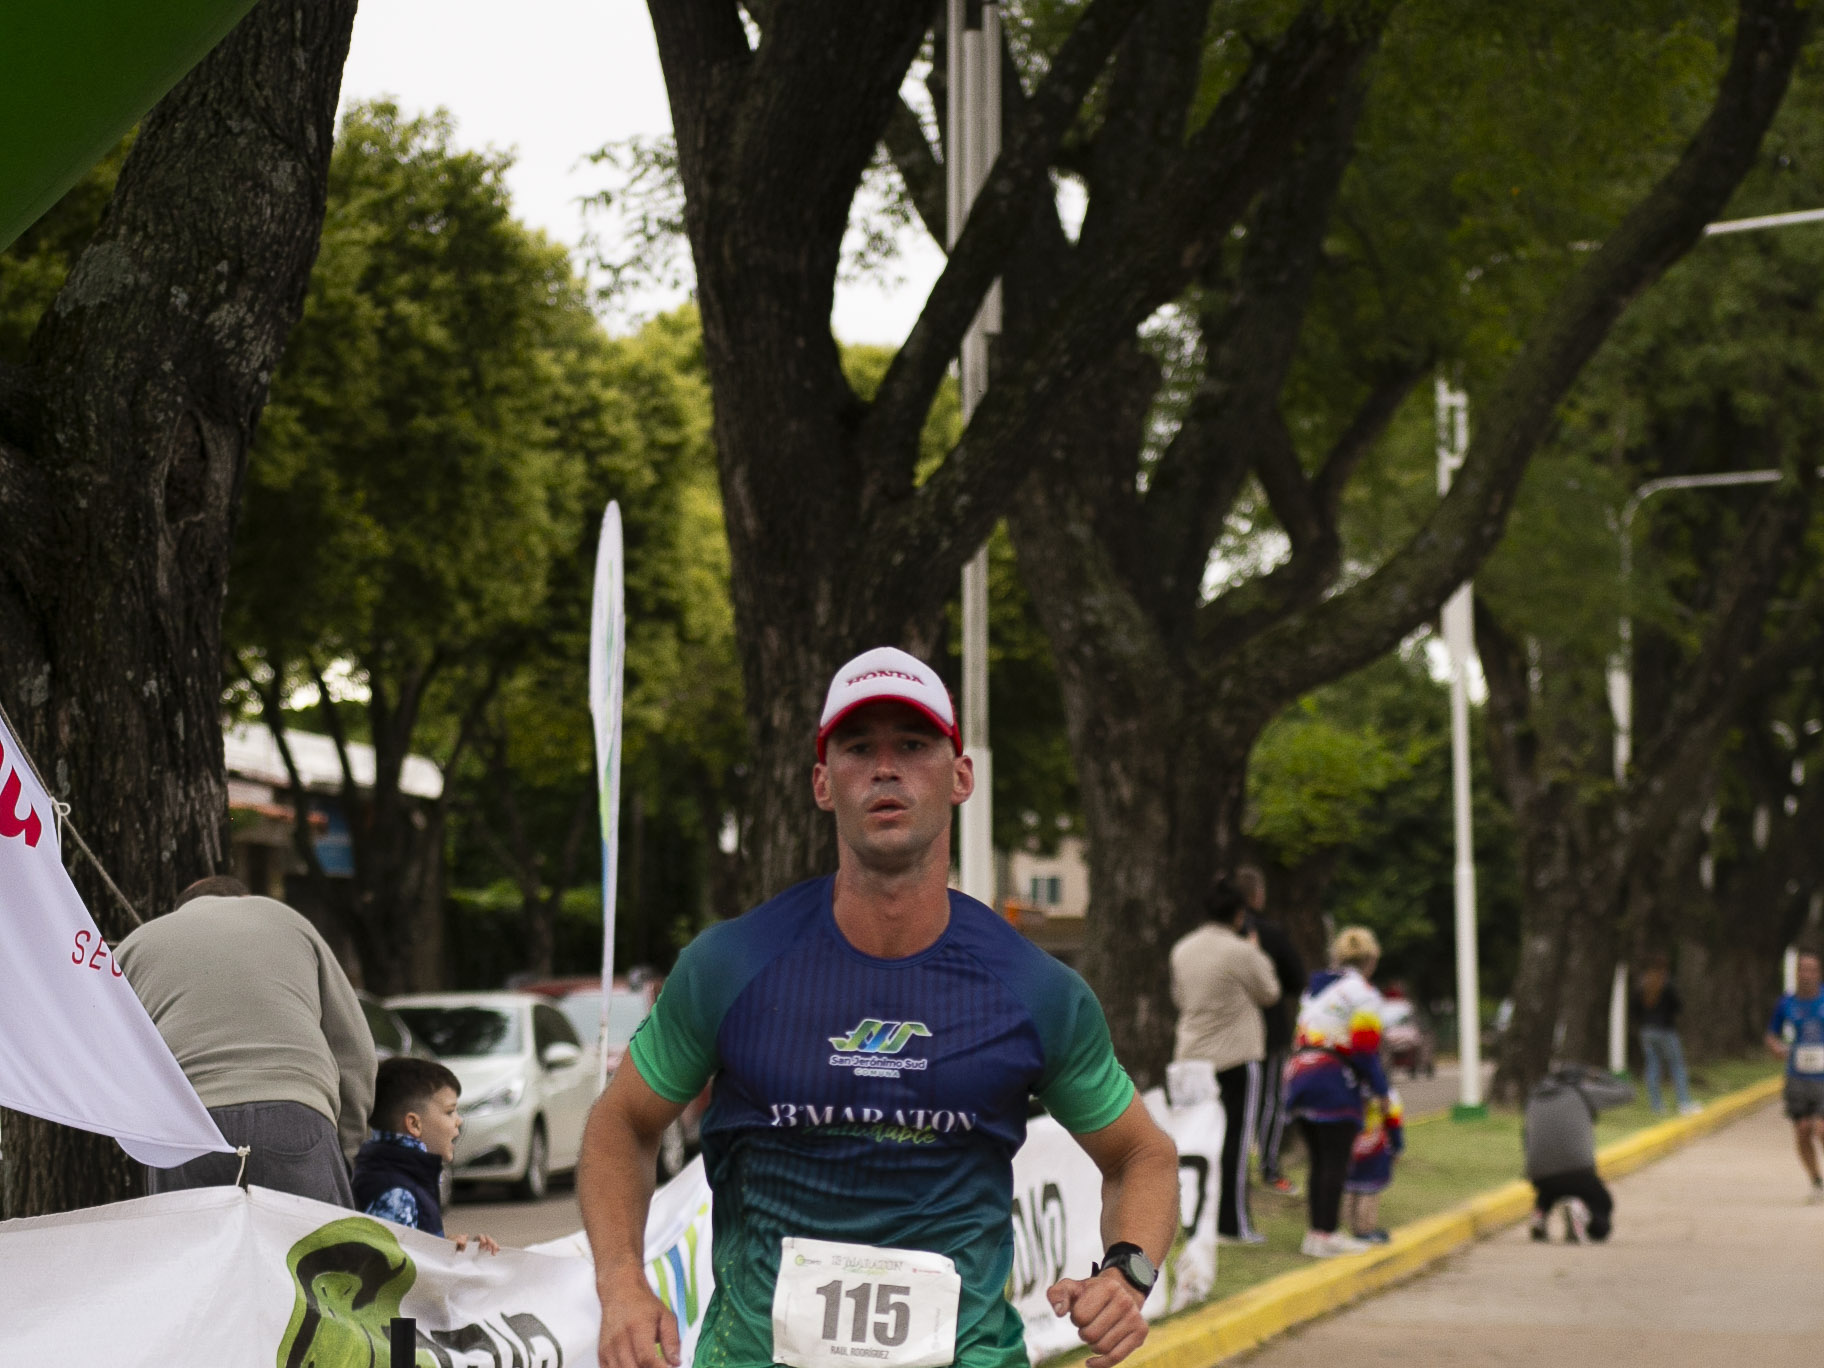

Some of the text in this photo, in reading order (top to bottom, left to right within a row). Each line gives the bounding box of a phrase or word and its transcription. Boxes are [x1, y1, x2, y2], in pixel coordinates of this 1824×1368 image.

[846, 670, 925, 686] HONDA
[829, 1055, 851, 1066] San
[904, 1058, 927, 1070] Sud
[854, 1068, 900, 1078] COMUNA
[816, 1279, 911, 1347] 115
